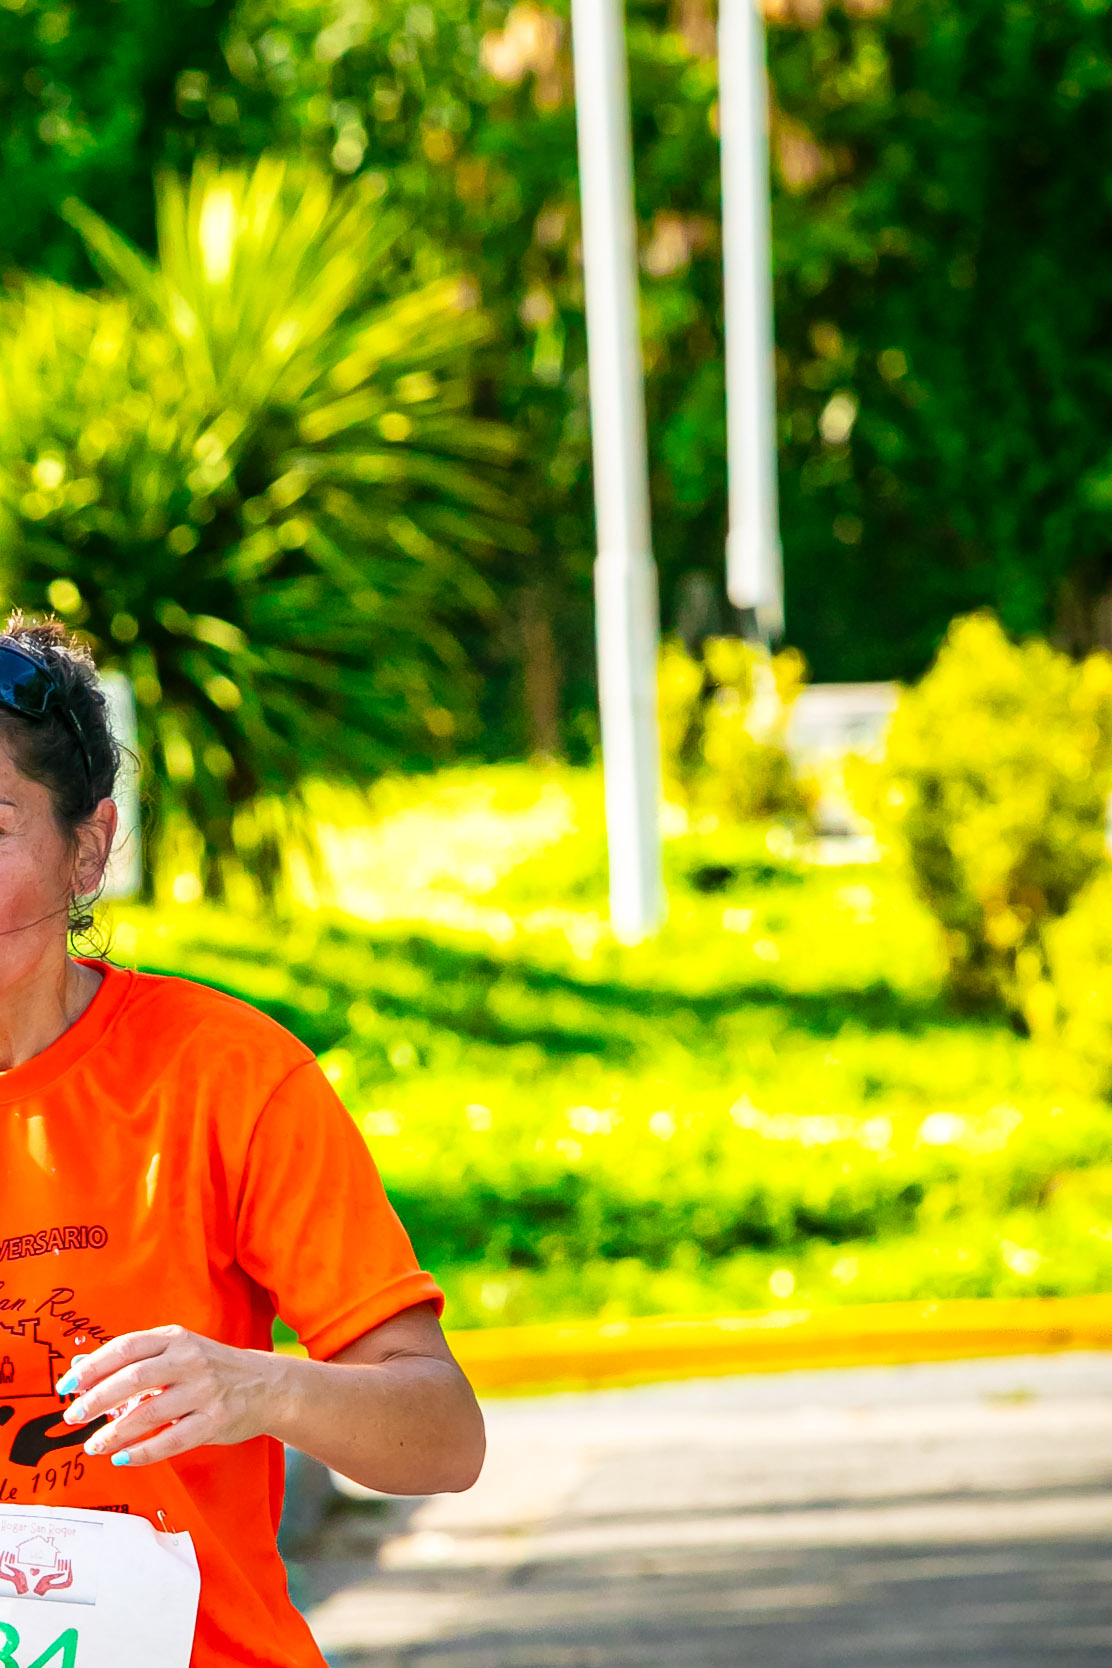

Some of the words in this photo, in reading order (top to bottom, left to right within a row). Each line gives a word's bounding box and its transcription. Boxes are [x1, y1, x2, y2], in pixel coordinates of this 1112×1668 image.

[35, 1288, 115, 1344] Roque
[32, 1451, 84, 1494] 1975
[1, 1519, 27, 1534] Hogar
[30, 1522, 46, 1534] San
[48, 1523, 77, 1537] Roque
